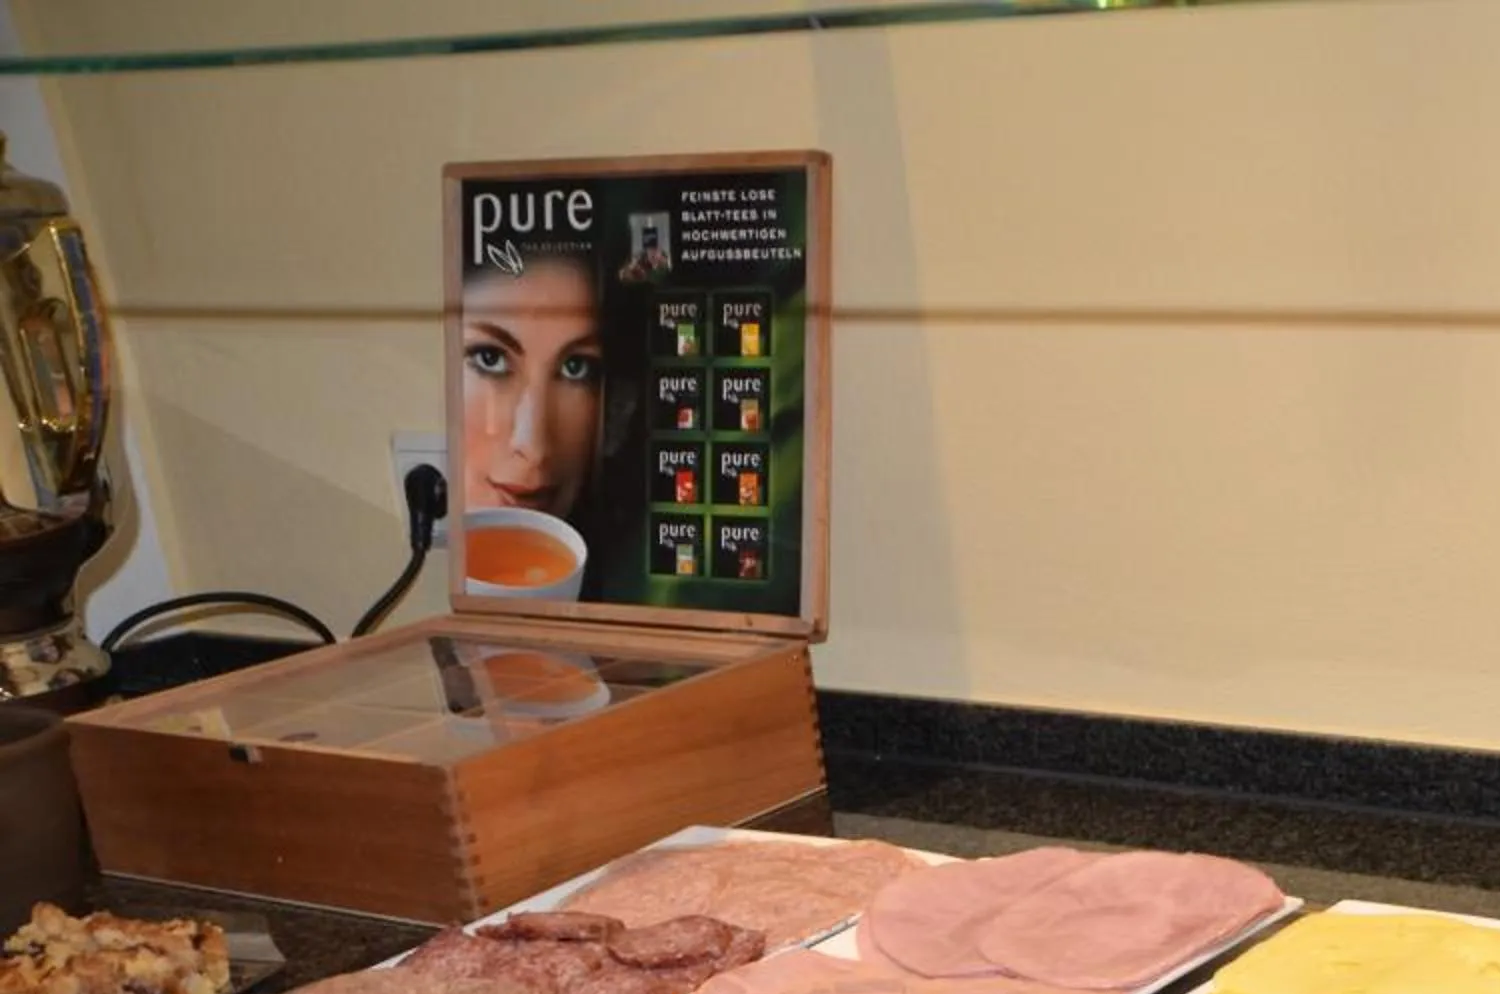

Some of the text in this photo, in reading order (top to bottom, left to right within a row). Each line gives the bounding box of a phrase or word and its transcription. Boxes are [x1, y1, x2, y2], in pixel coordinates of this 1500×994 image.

[681, 188, 776, 202] FEINSTE LOSE
[681, 208, 777, 222] BLATT-TEES IN
[474, 189, 593, 265] pure
[681, 228, 787, 241] HOCHWERTIGEN
[681, 247, 802, 261] AUFGUSSBEUTELN
[659, 303, 698, 327] pure
[723, 303, 763, 326] pure
[659, 376, 698, 400] pure
[722, 377, 761, 401] pure
[659, 450, 697, 474] pure
[721, 452, 761, 475] pure
[659, 523, 696, 545] pure
[721, 525, 760, 550] pure
